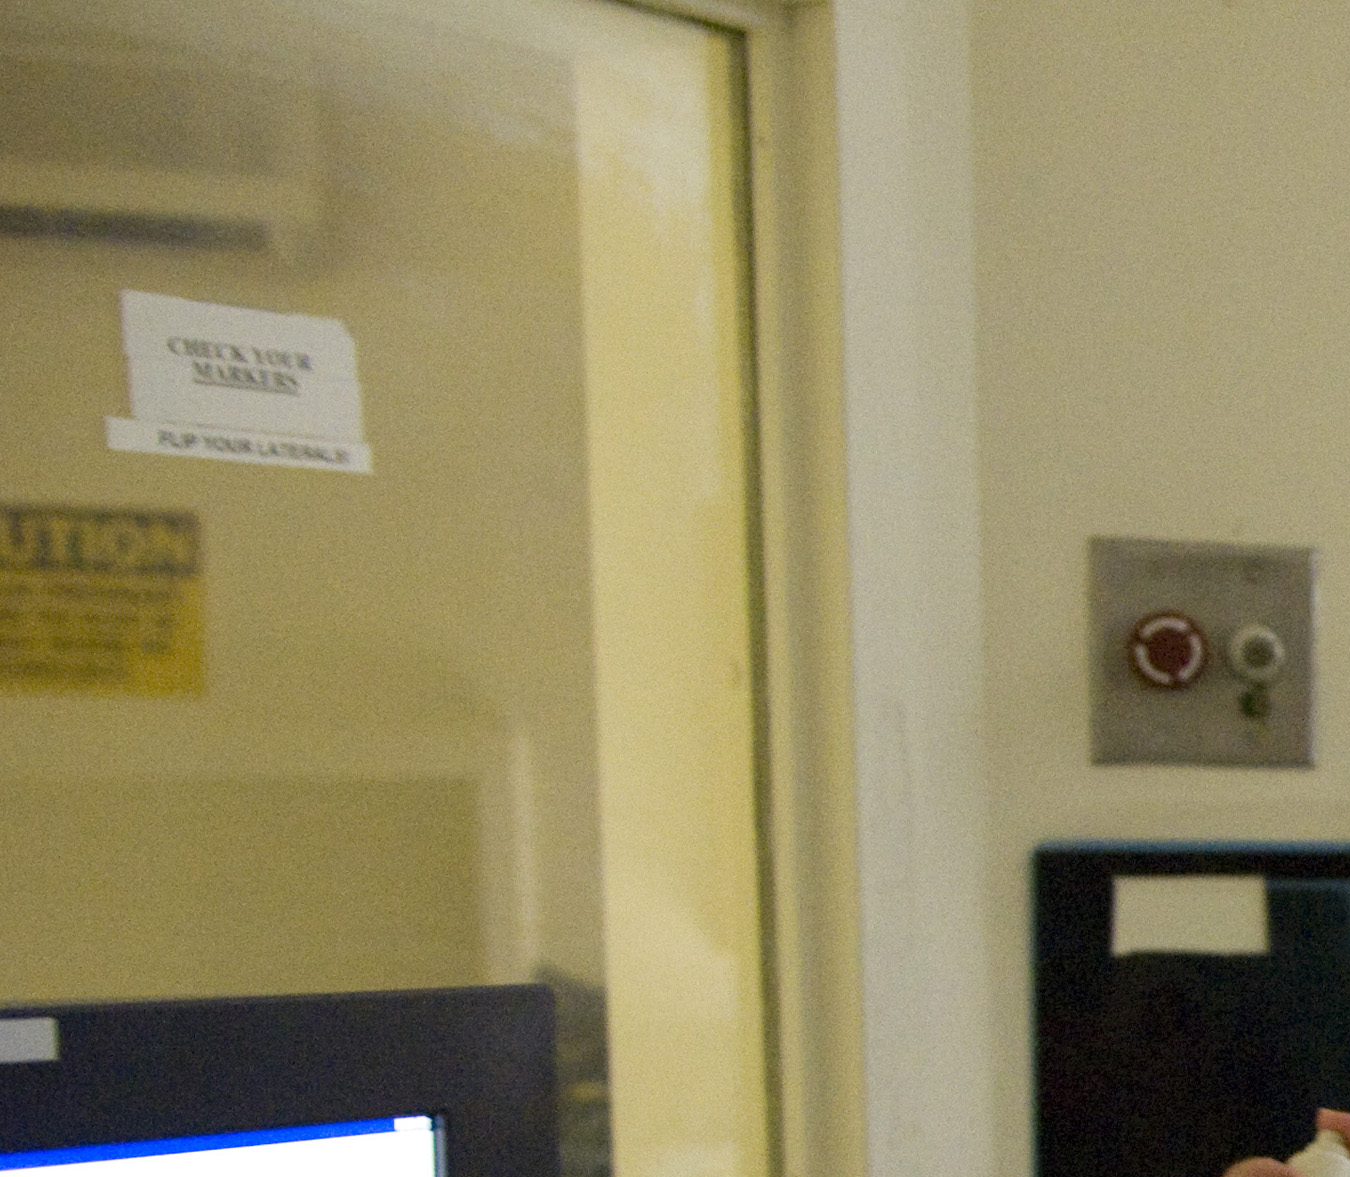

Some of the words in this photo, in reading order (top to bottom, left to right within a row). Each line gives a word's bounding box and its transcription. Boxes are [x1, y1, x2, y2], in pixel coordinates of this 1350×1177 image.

[167, 336, 247, 363] CHECK
[252, 346, 313, 371] YOUR
[192, 361, 300, 390] MARKERS
[157, 429, 197, 449] FLIP
[203, 434, 252, 455] YOUR
